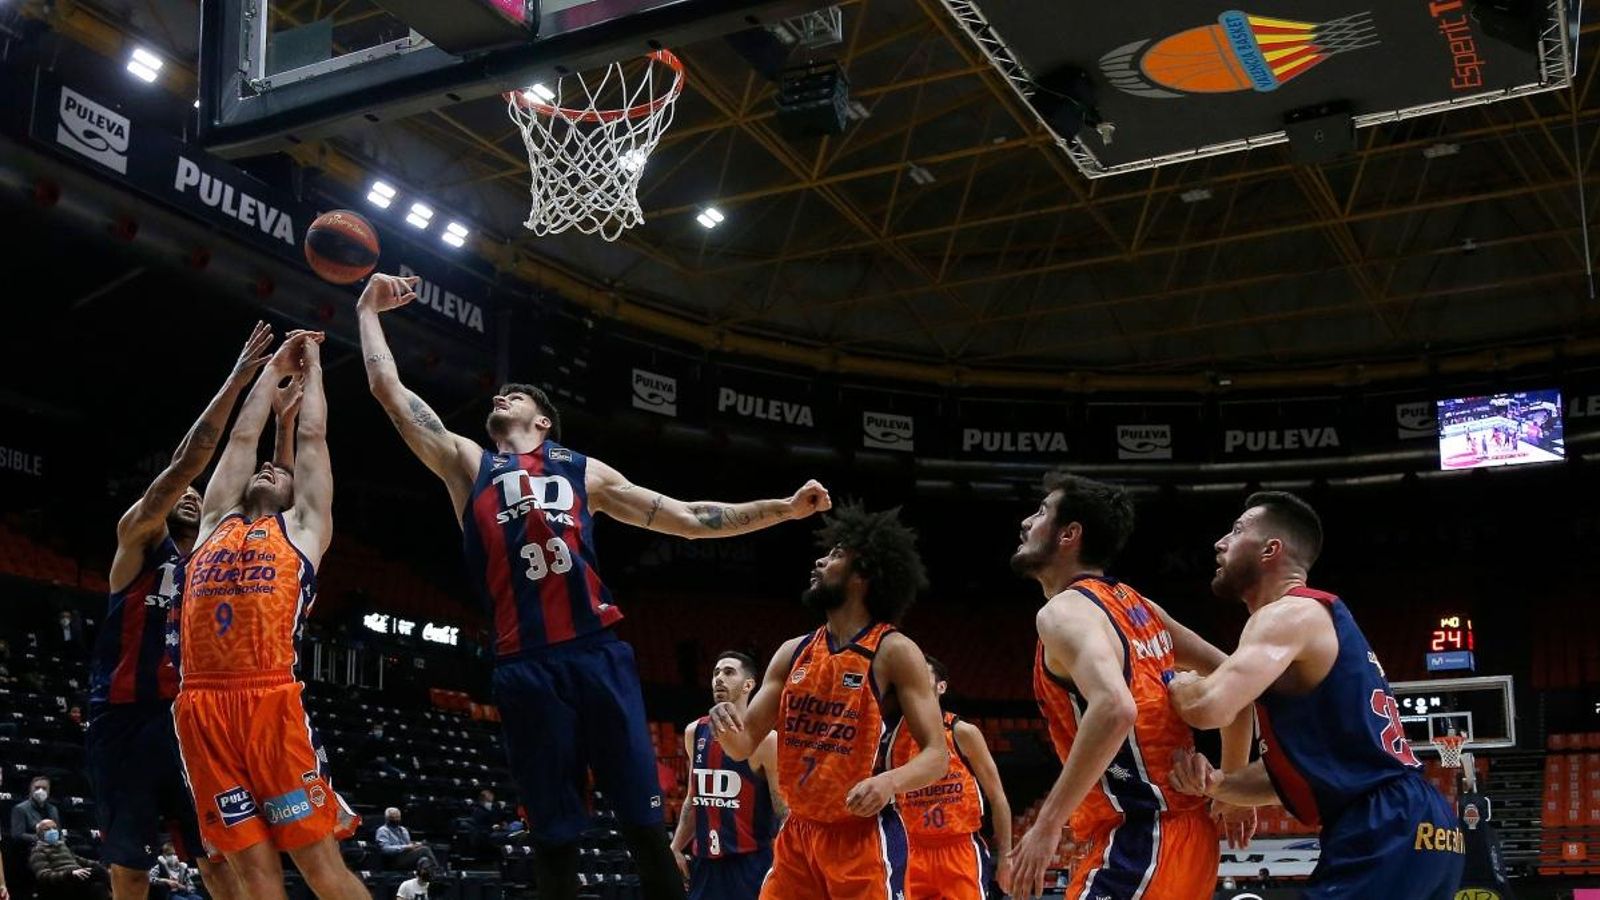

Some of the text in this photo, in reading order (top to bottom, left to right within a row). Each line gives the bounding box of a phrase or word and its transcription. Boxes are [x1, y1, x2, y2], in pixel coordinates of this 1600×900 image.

[64, 95, 126, 140] PULEVA
[175, 156, 295, 246] PULEVA
[635, 374, 674, 394] PULEVA
[718, 387, 814, 428] PULEVA
[866, 415, 911, 433] PULEVA
[1121, 428, 1168, 441] PULEVA
[962, 428, 1069, 453] PULEVA
[1224, 426, 1341, 453] PULEVA
[492, 469, 574, 511] TD
[521, 537, 573, 581] 33
[192, 566, 276, 586] Esfuerzo
[216, 603, 233, 638] 9
[1432, 630, 1462, 651] 24
[788, 694, 845, 717] ultura
[785, 715, 857, 741] sfuerzo
[693, 768, 742, 798] TD
[803, 756, 816, 786] 7
[709, 829, 721, 857] 3
